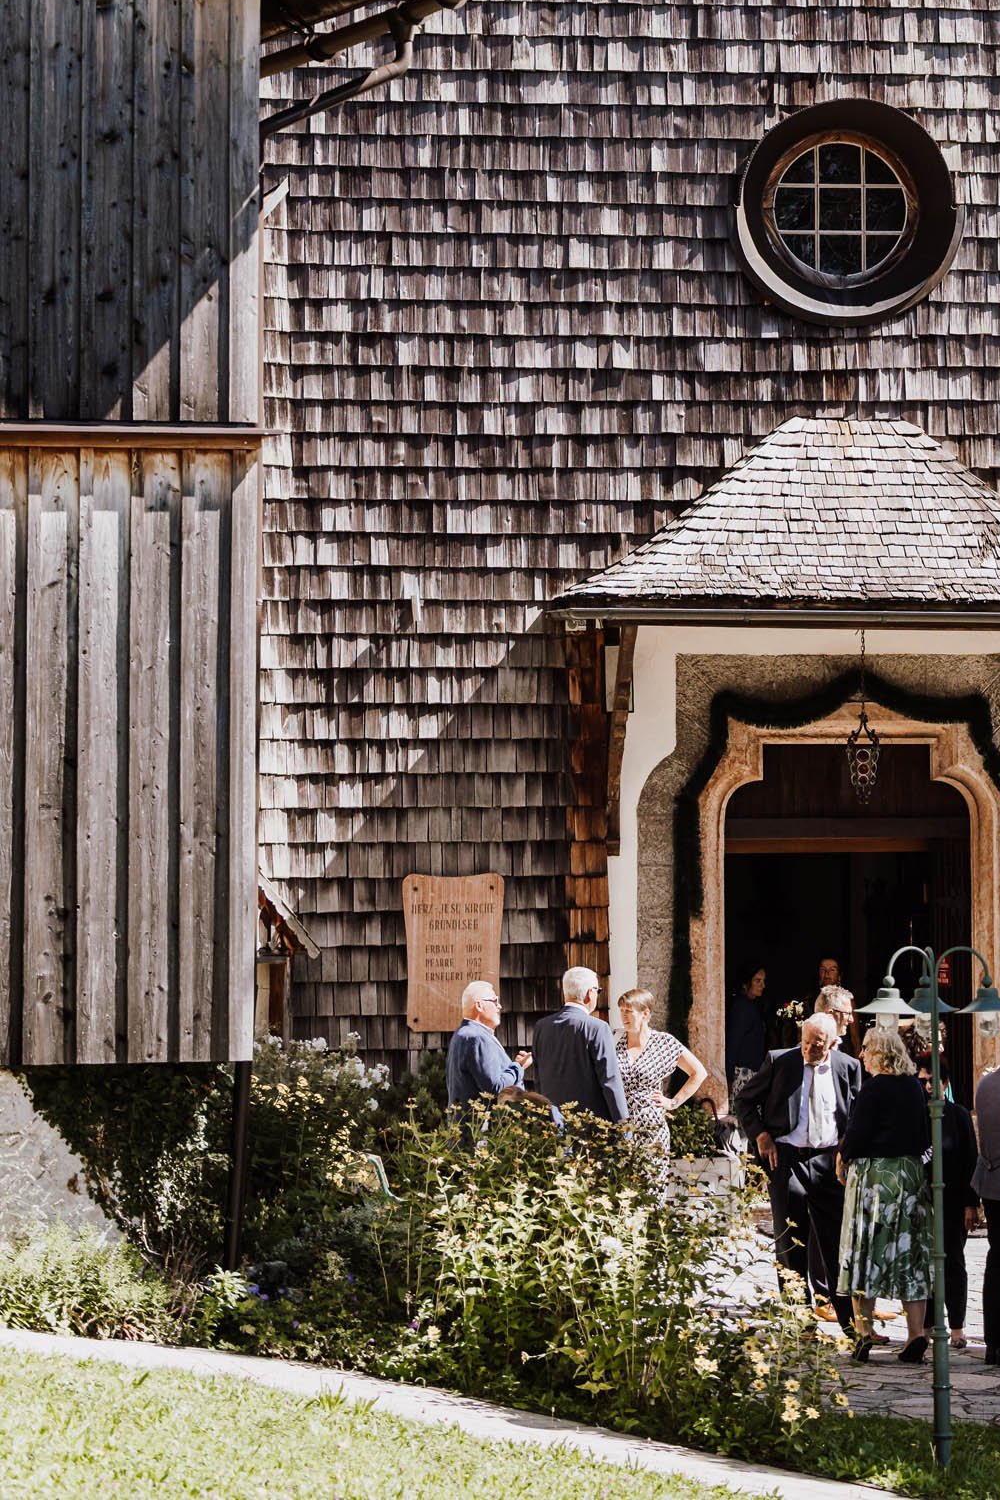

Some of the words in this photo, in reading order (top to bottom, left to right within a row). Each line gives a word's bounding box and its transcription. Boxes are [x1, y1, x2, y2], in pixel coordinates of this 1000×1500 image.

[464, 902, 495, 913] KIRCHE
[428, 918, 479, 930] GRUNDLSEE
[425, 944, 454, 954] ERBAUT
[466, 943, 482, 953] 1890
[425, 958, 454, 967] PFARRE
[425, 971, 463, 981] ERNEUERT
[466, 971, 482, 981] 1977
